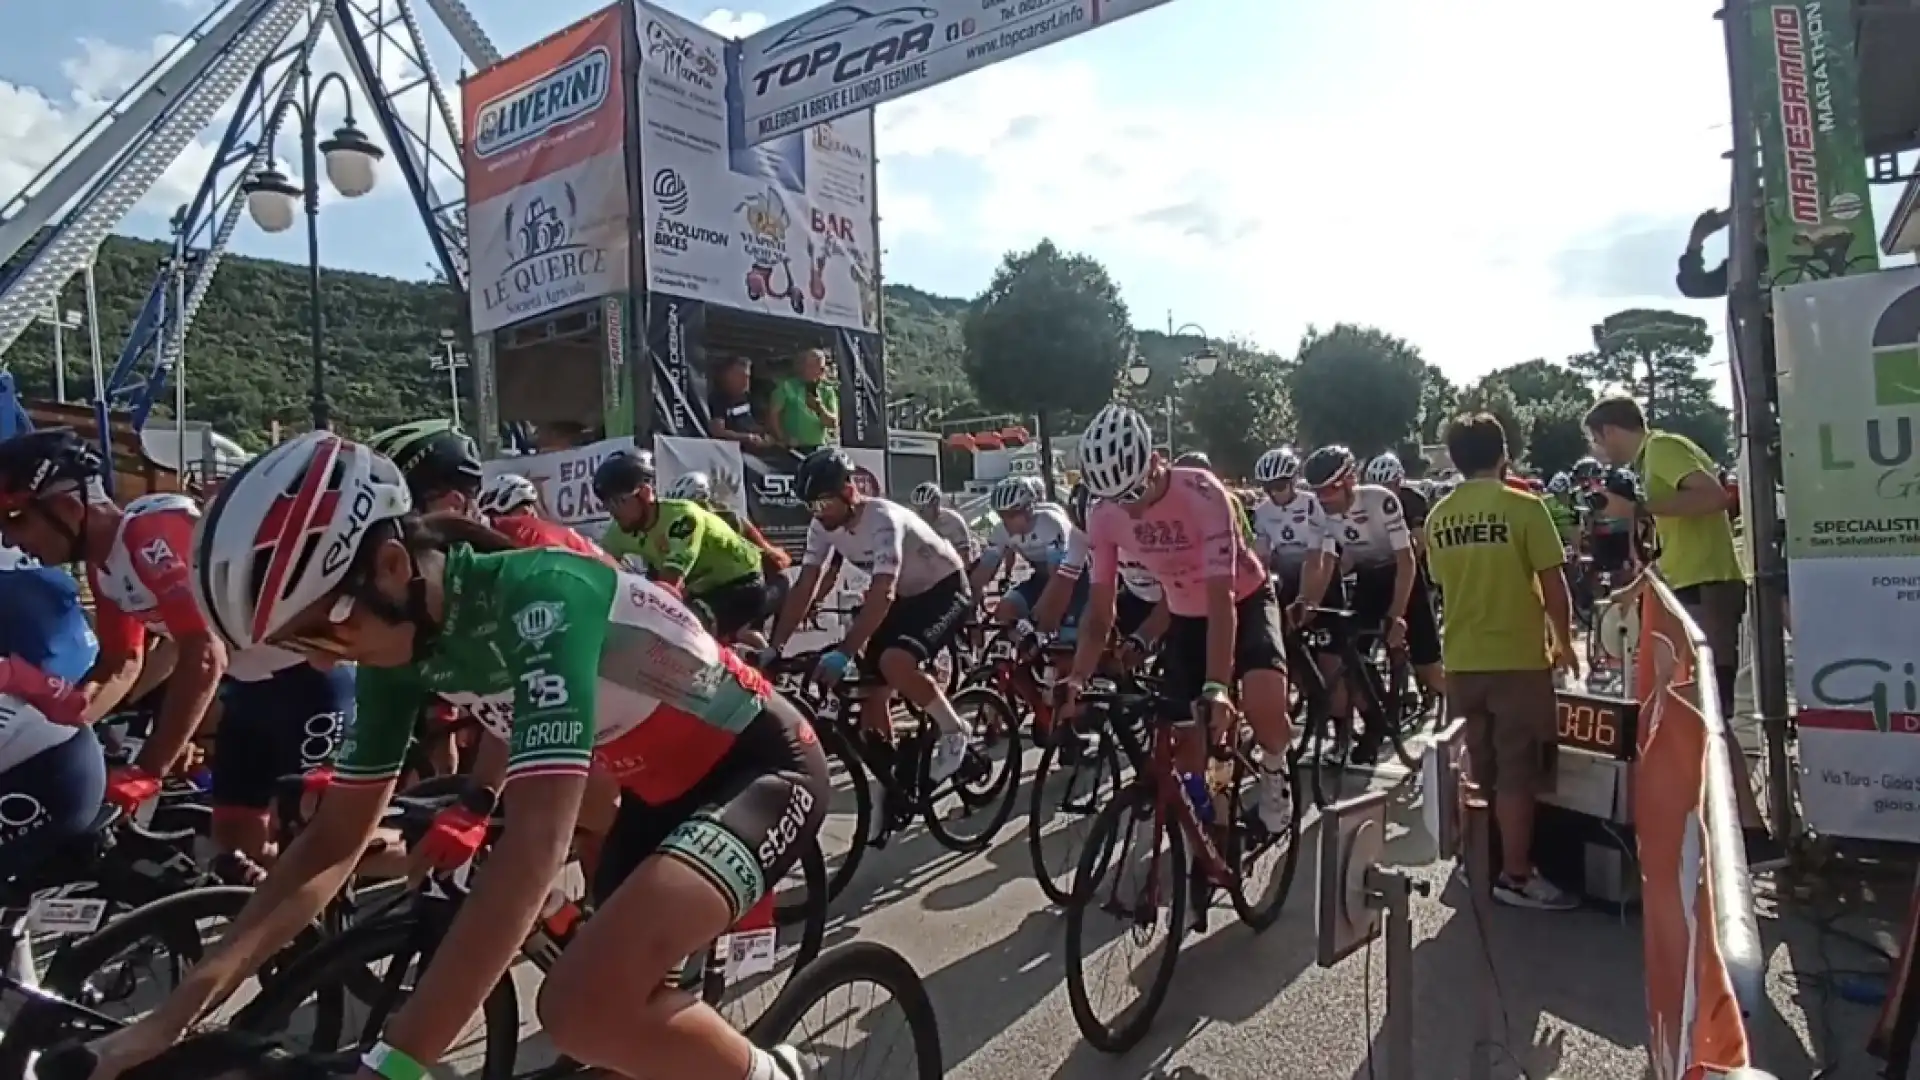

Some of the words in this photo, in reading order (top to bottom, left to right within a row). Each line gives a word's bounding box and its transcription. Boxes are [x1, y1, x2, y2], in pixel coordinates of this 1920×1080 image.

[1806, 1, 1836, 132] MARATHON
[811, 207, 854, 243] BAR
[483, 277, 510, 311] LE
[514, 248, 606, 294] QUERCE
[1433, 523, 1508, 549] TIMER
[526, 720, 584, 748] GROUP
